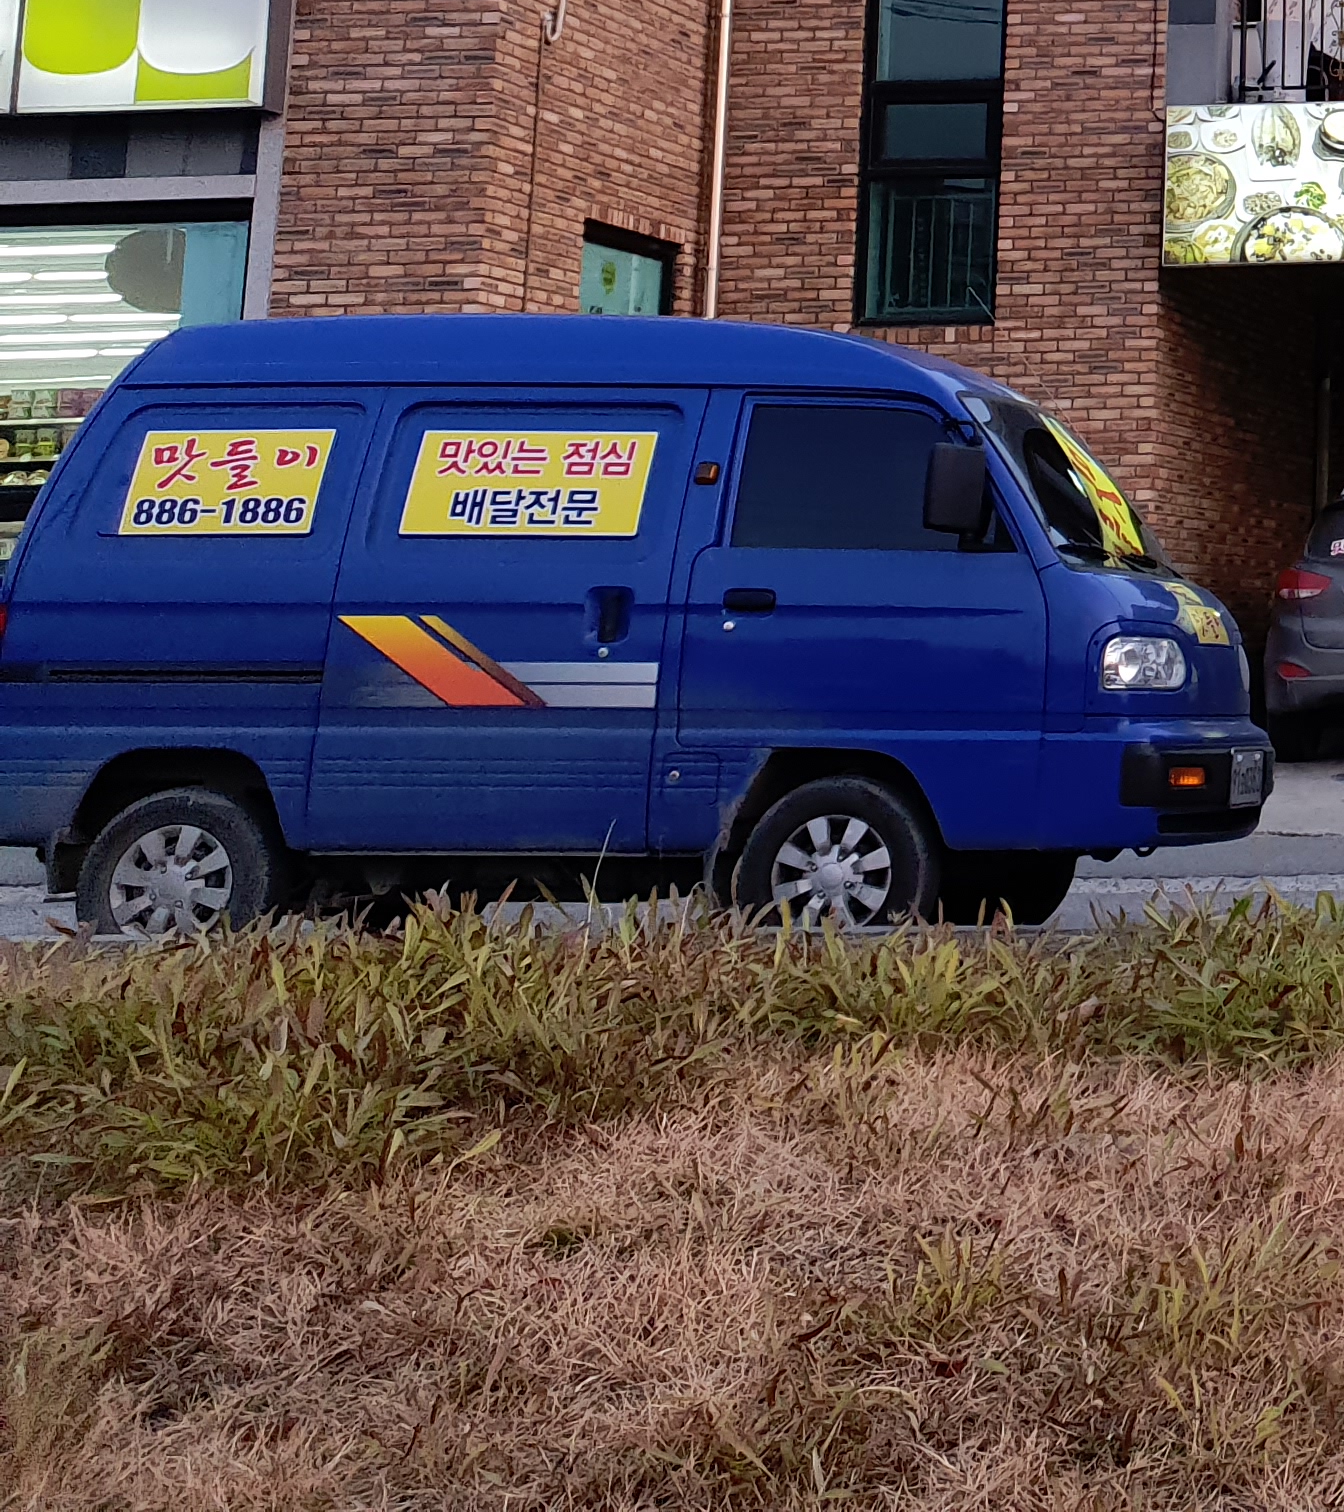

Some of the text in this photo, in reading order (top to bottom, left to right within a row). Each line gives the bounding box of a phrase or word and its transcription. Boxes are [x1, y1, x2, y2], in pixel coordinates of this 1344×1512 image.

[153, 437, 319, 491] 맛들이
[437, 439, 637, 478] 맛있는 점심
[132, 496, 306, 527] 886-1886
[448, 488, 600, 527] 배달전문
